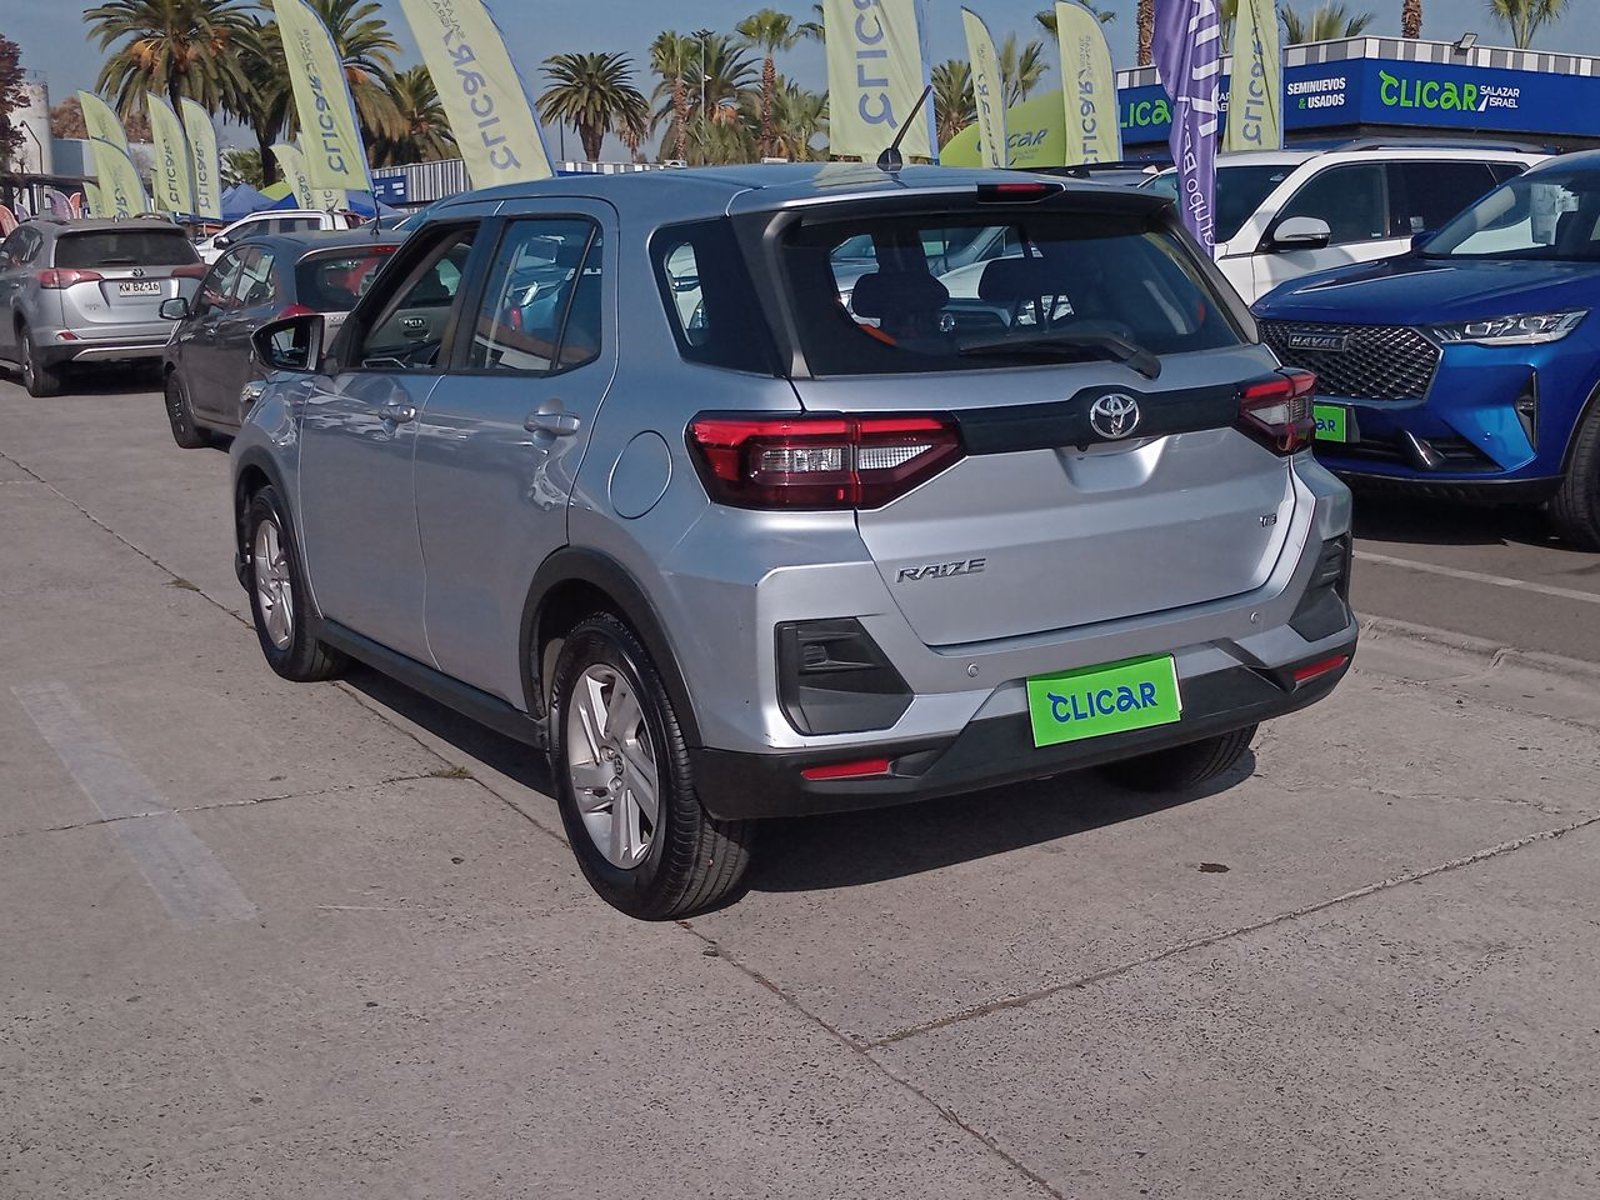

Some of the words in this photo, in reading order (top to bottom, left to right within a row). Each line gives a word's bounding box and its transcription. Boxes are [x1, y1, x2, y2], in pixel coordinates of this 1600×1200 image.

[1287, 77, 1346, 96] SEMINUEVOS
[1480, 85, 1520, 98] SALAZAR
[1298, 97, 1306, 109] &
[1308, 93, 1345, 109] USADOS
[1489, 97, 1519, 109] ISRAEL
[119, 284, 132, 293] KW
[1291, 335, 1339, 348] HAVAL
[896, 557, 987, 583] RAIZE
